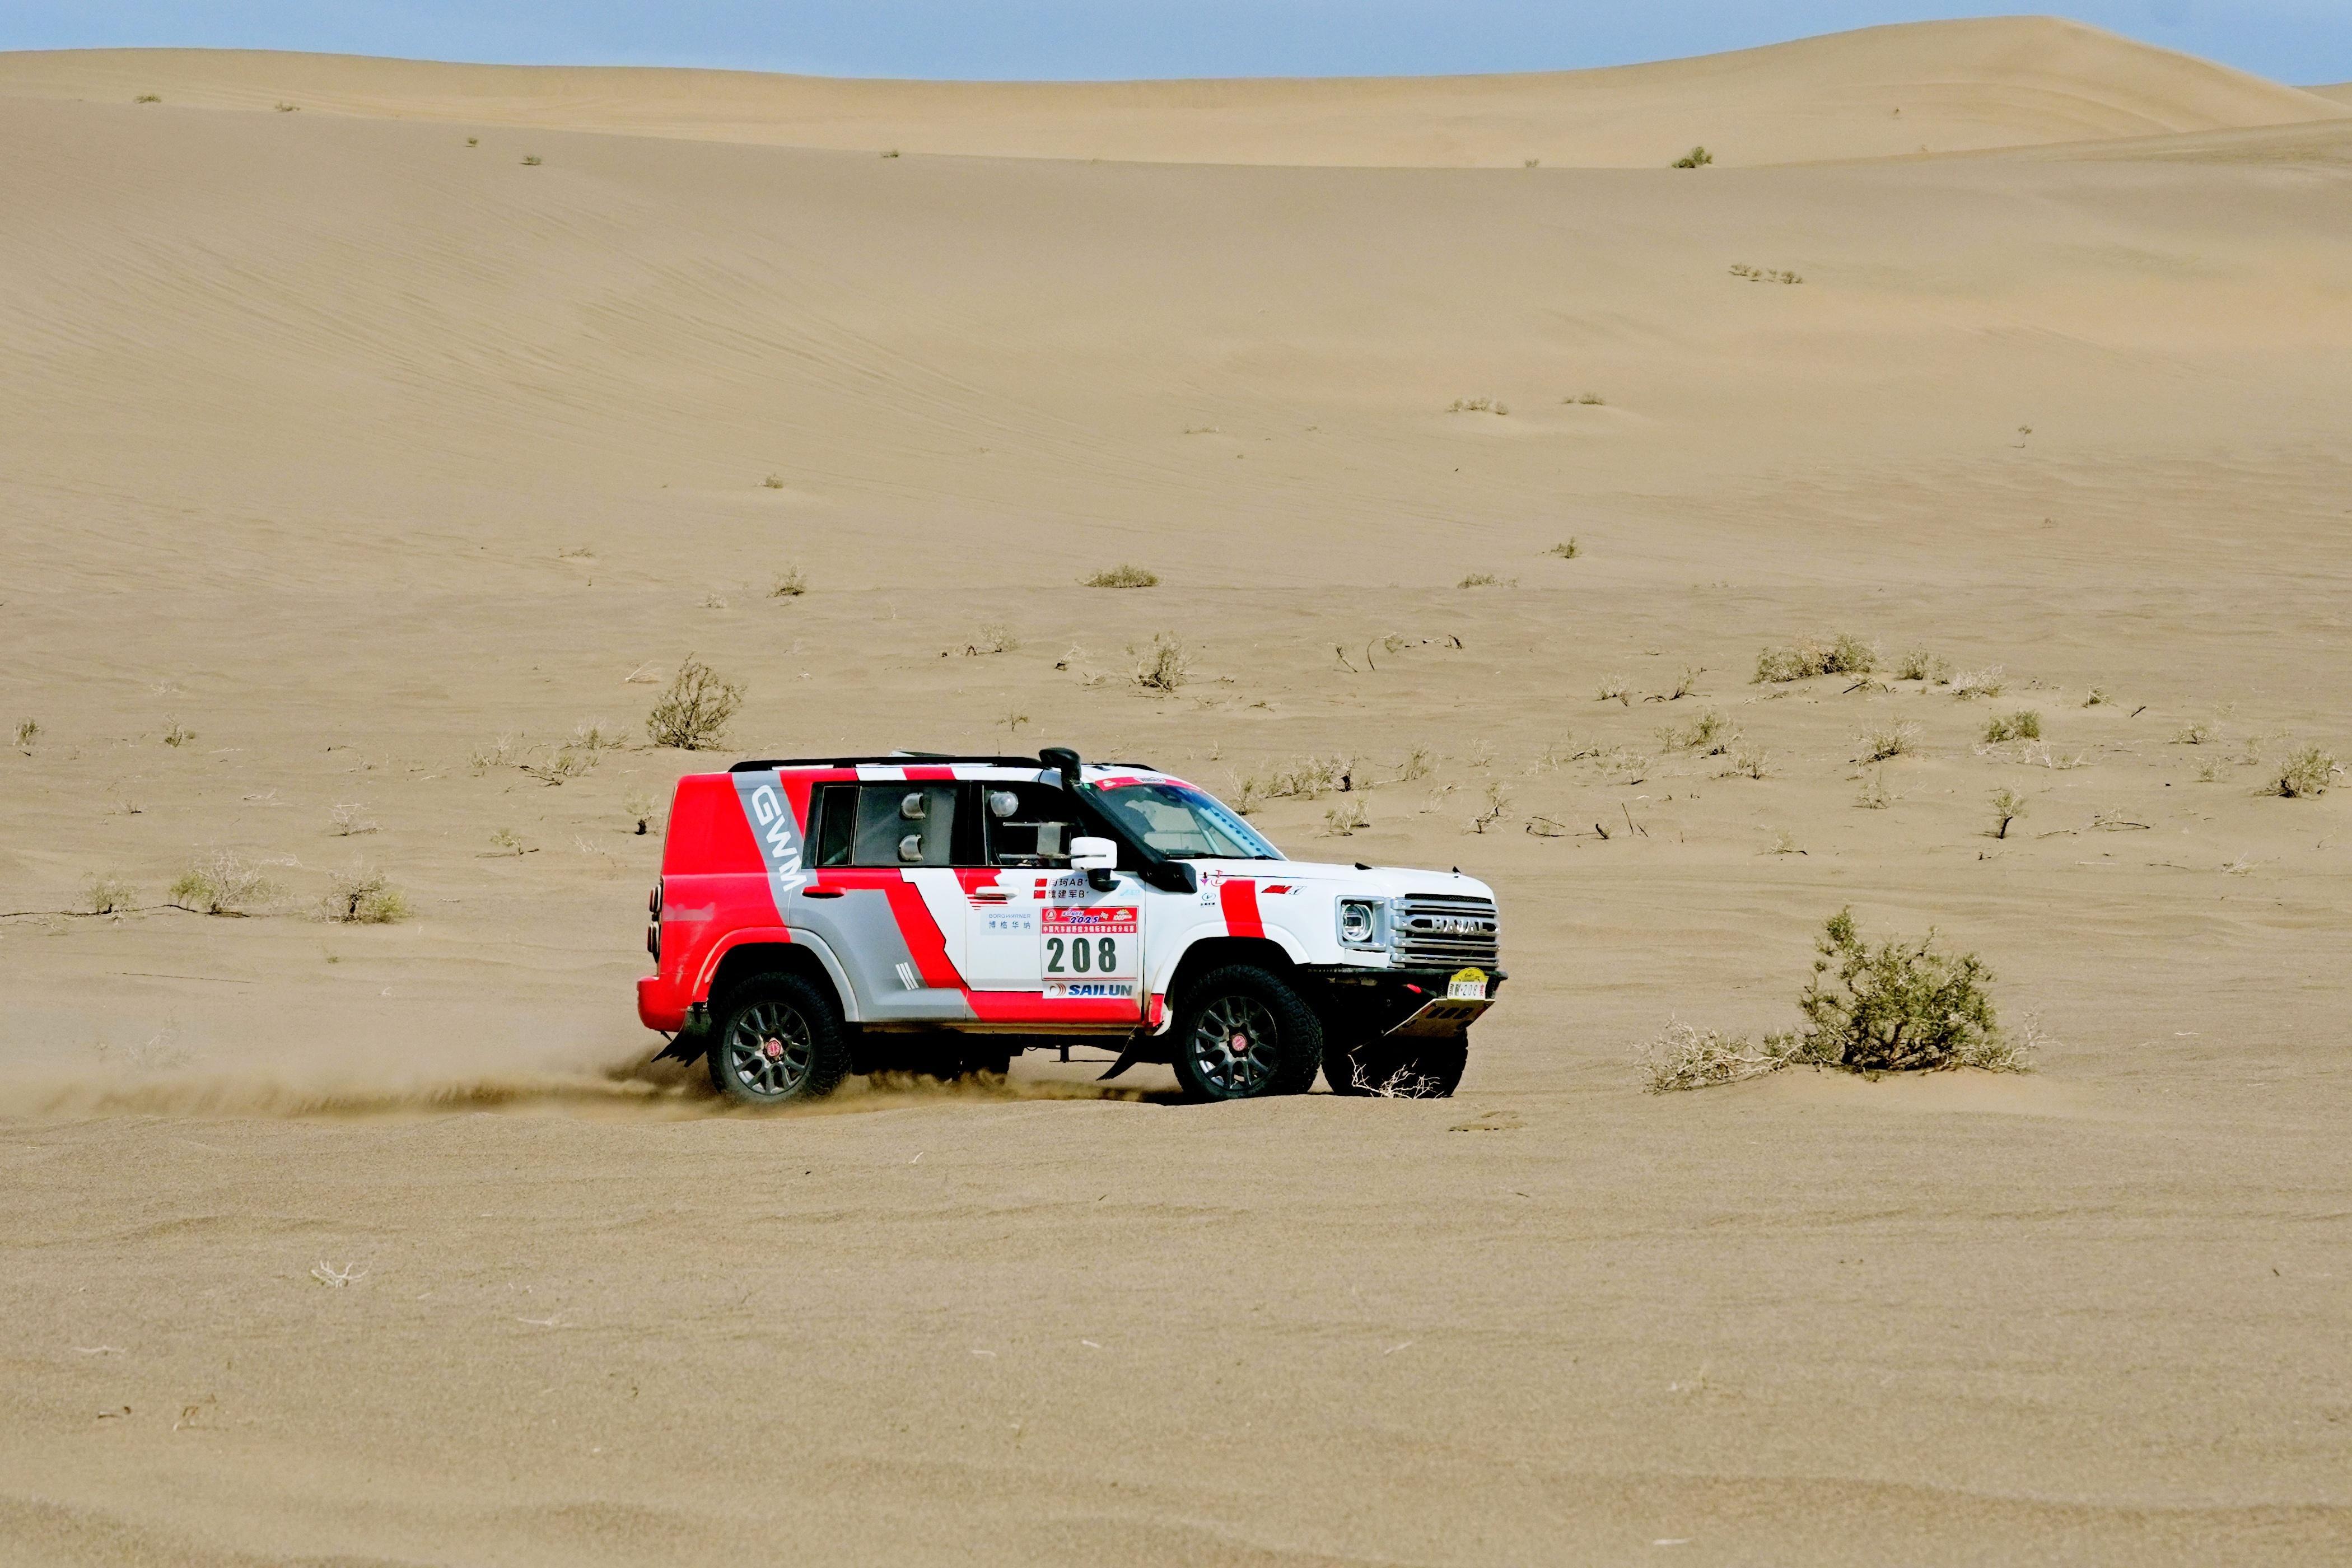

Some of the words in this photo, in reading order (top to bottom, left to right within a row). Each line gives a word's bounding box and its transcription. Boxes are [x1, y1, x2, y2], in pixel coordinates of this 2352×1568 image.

[752, 785, 807, 892] GWM
[989, 921, 1031, 930] 博格华纳
[1047, 937, 1117, 973] 208
[1068, 984, 1133, 996] SAILUN
